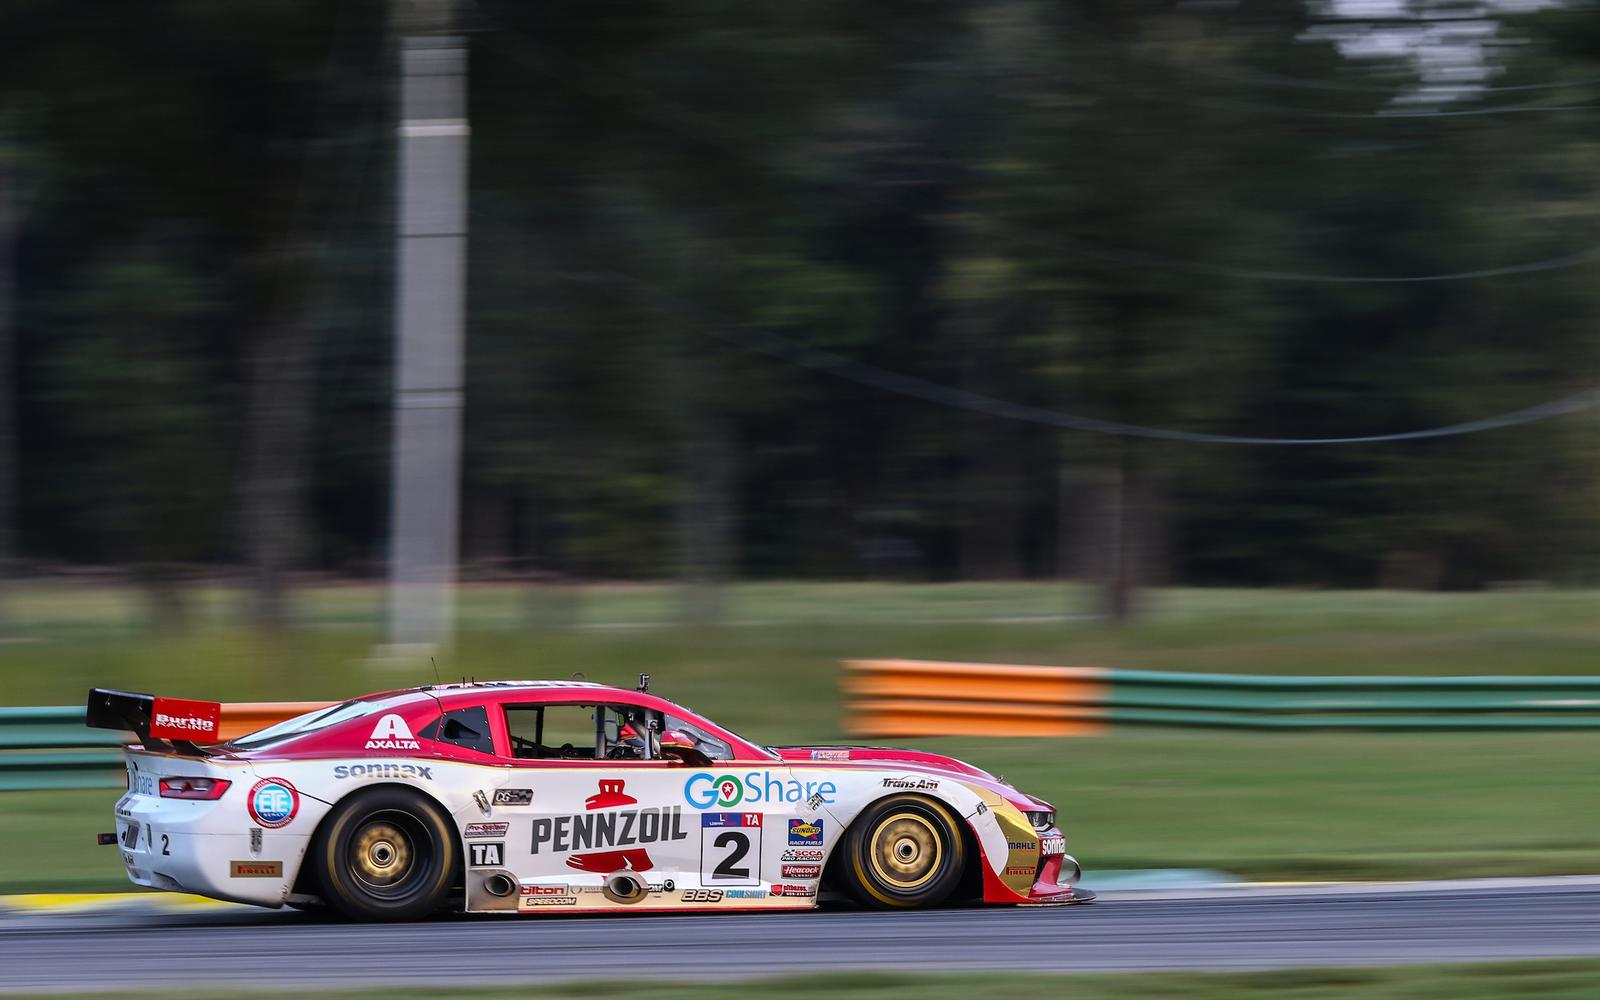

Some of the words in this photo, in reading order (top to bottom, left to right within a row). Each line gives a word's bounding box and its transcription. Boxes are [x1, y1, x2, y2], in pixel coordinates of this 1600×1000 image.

[155, 720, 214, 731] RACING
[156, 713, 214, 727] Burtin
[365, 741, 420, 749] AXALTA
[334, 764, 433, 780] sonnax
[883, 778, 915, 788] Trans
[917, 780, 939, 789] Am
[745, 814, 760, 826] TA
[531, 805, 688, 854] PENNZOIL
[791, 826, 820, 834] SUNOCO
[161, 834, 170, 856] 2
[1008, 842, 1036, 850] MAHLE
[472, 845, 500, 865] TA
[711, 831, 750, 879] 2
[237, 865, 276, 874] PIRELLI
[784, 866, 819, 874] Heacock
[1006, 867, 1036, 875] PIRELLI
[520, 886, 564, 895] tilton
[681, 889, 722, 902] BBS
[725, 890, 767, 898] COOLSHIRT
